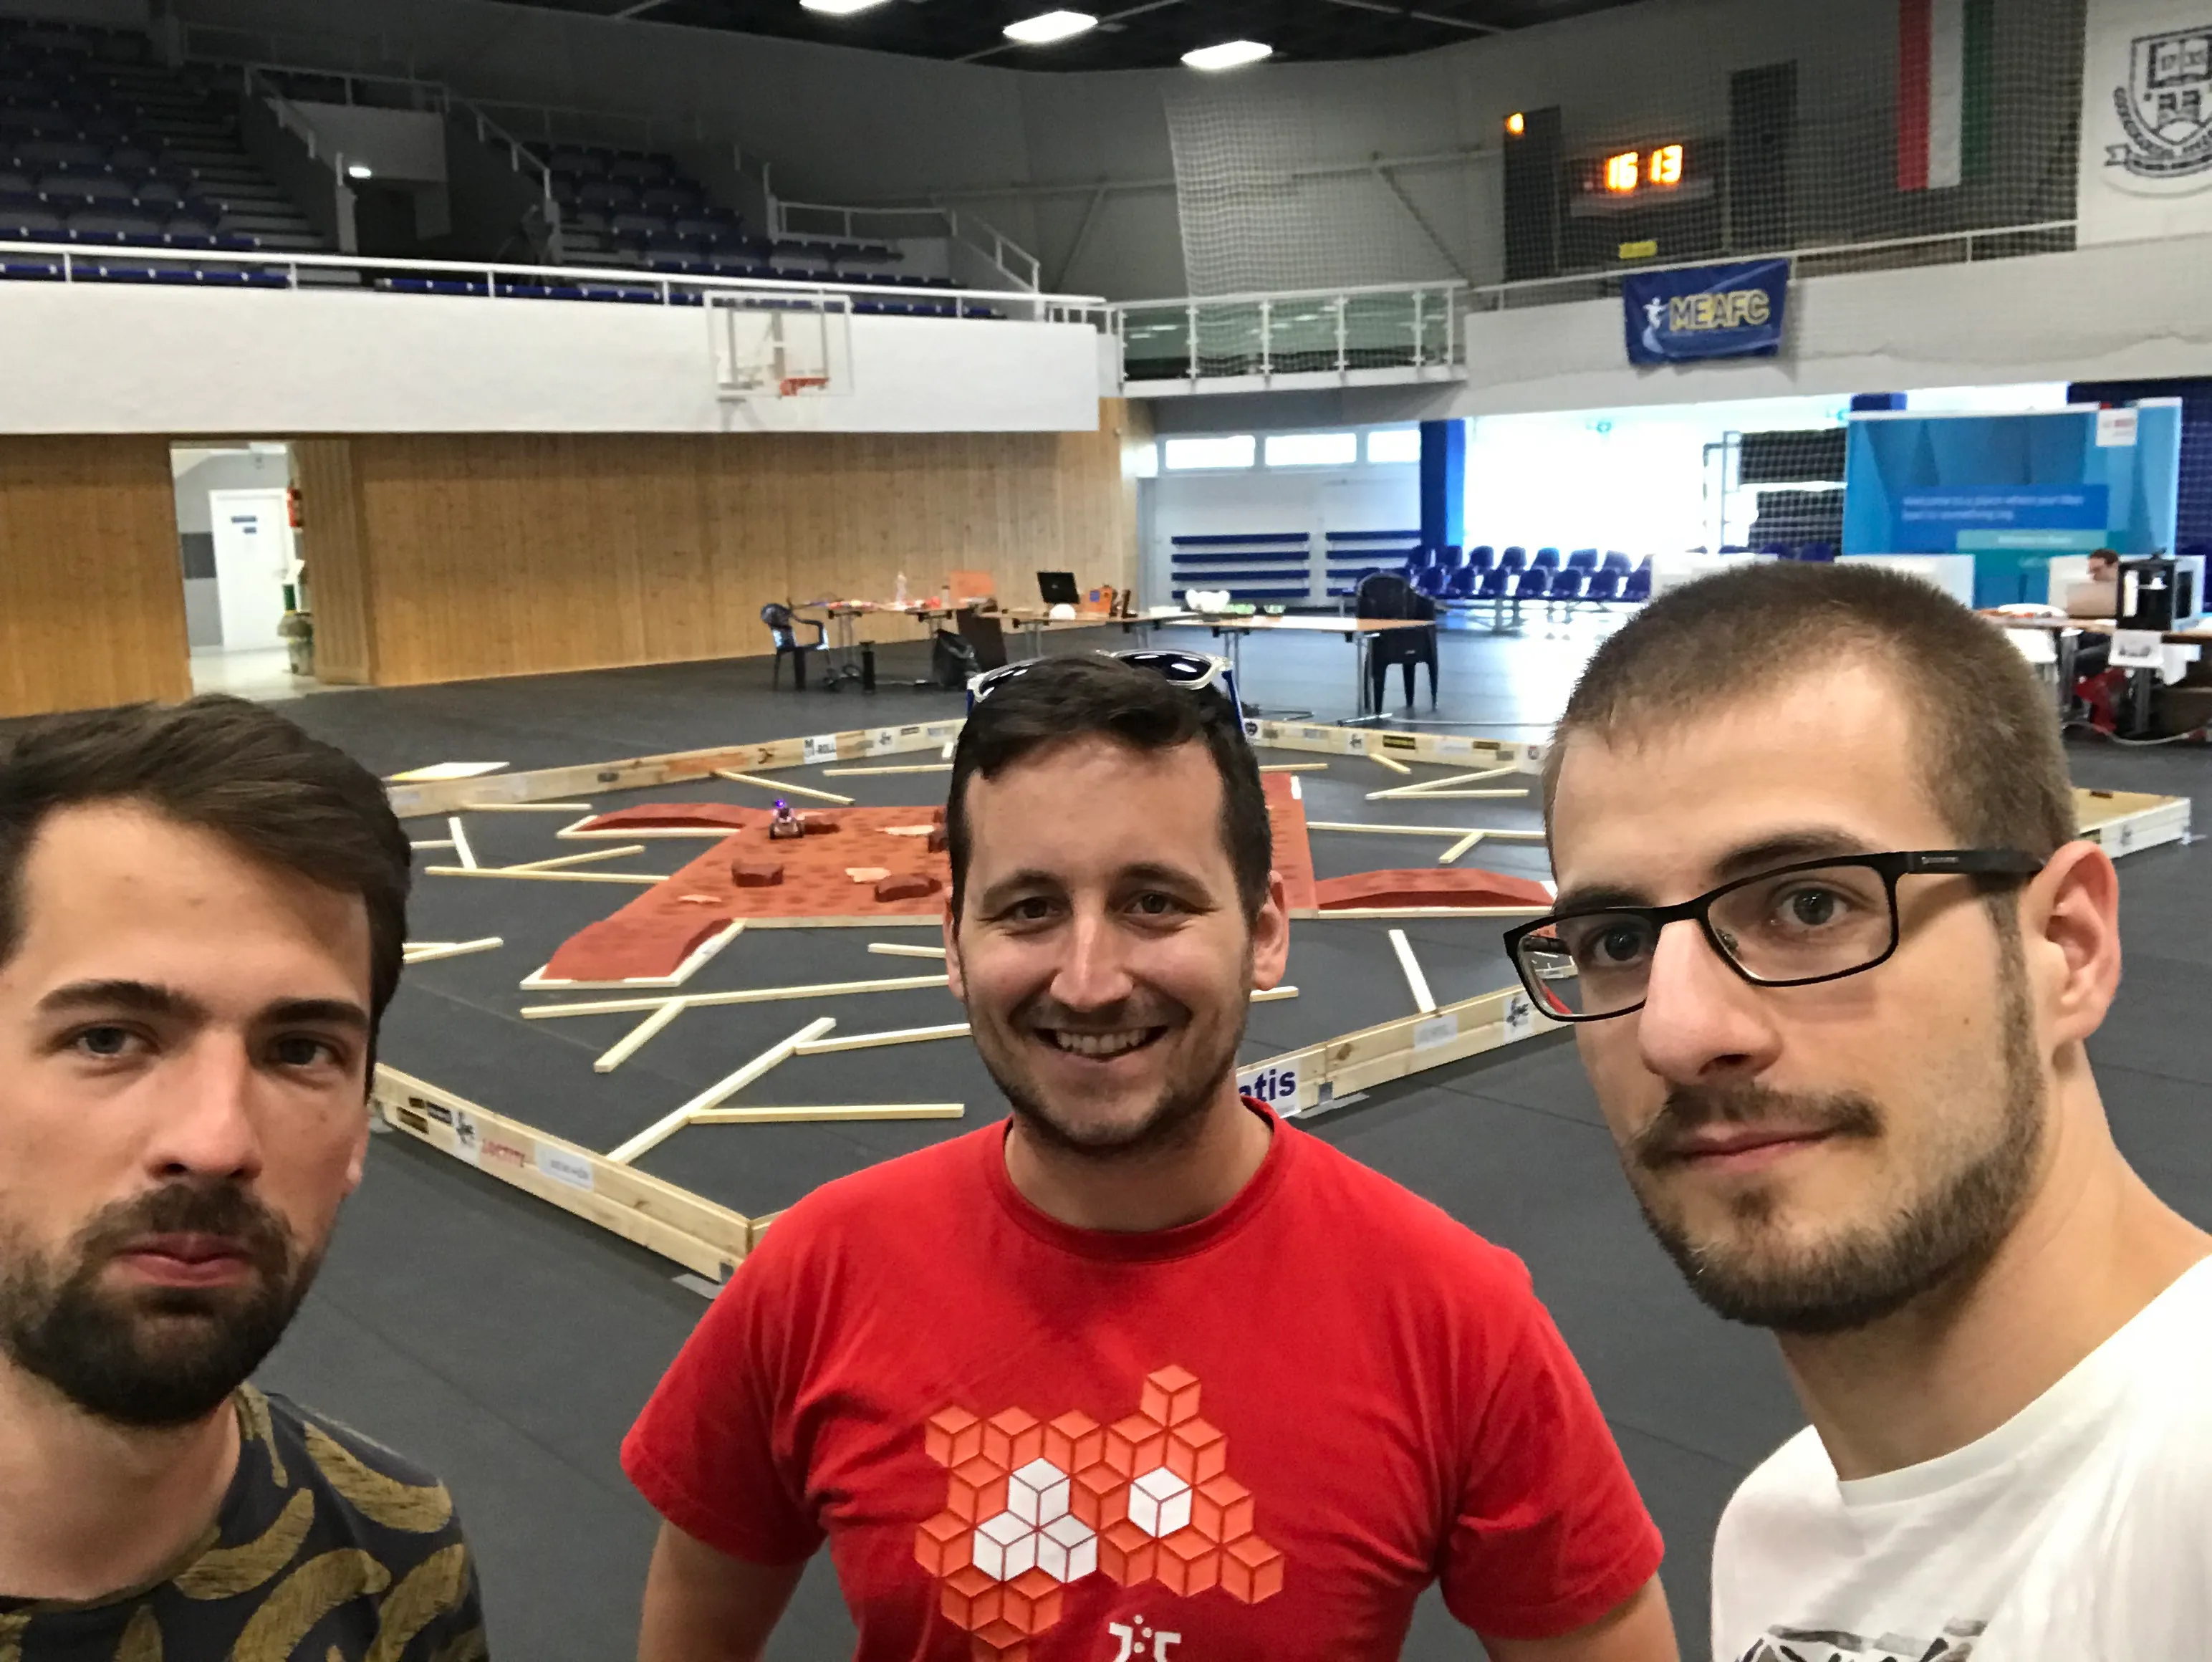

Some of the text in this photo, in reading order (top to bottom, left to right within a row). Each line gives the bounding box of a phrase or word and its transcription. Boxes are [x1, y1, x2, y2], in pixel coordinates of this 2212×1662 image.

[1607, 144, 1683, 191] 16 13
[1669, 289, 1771, 331] MEAFC
